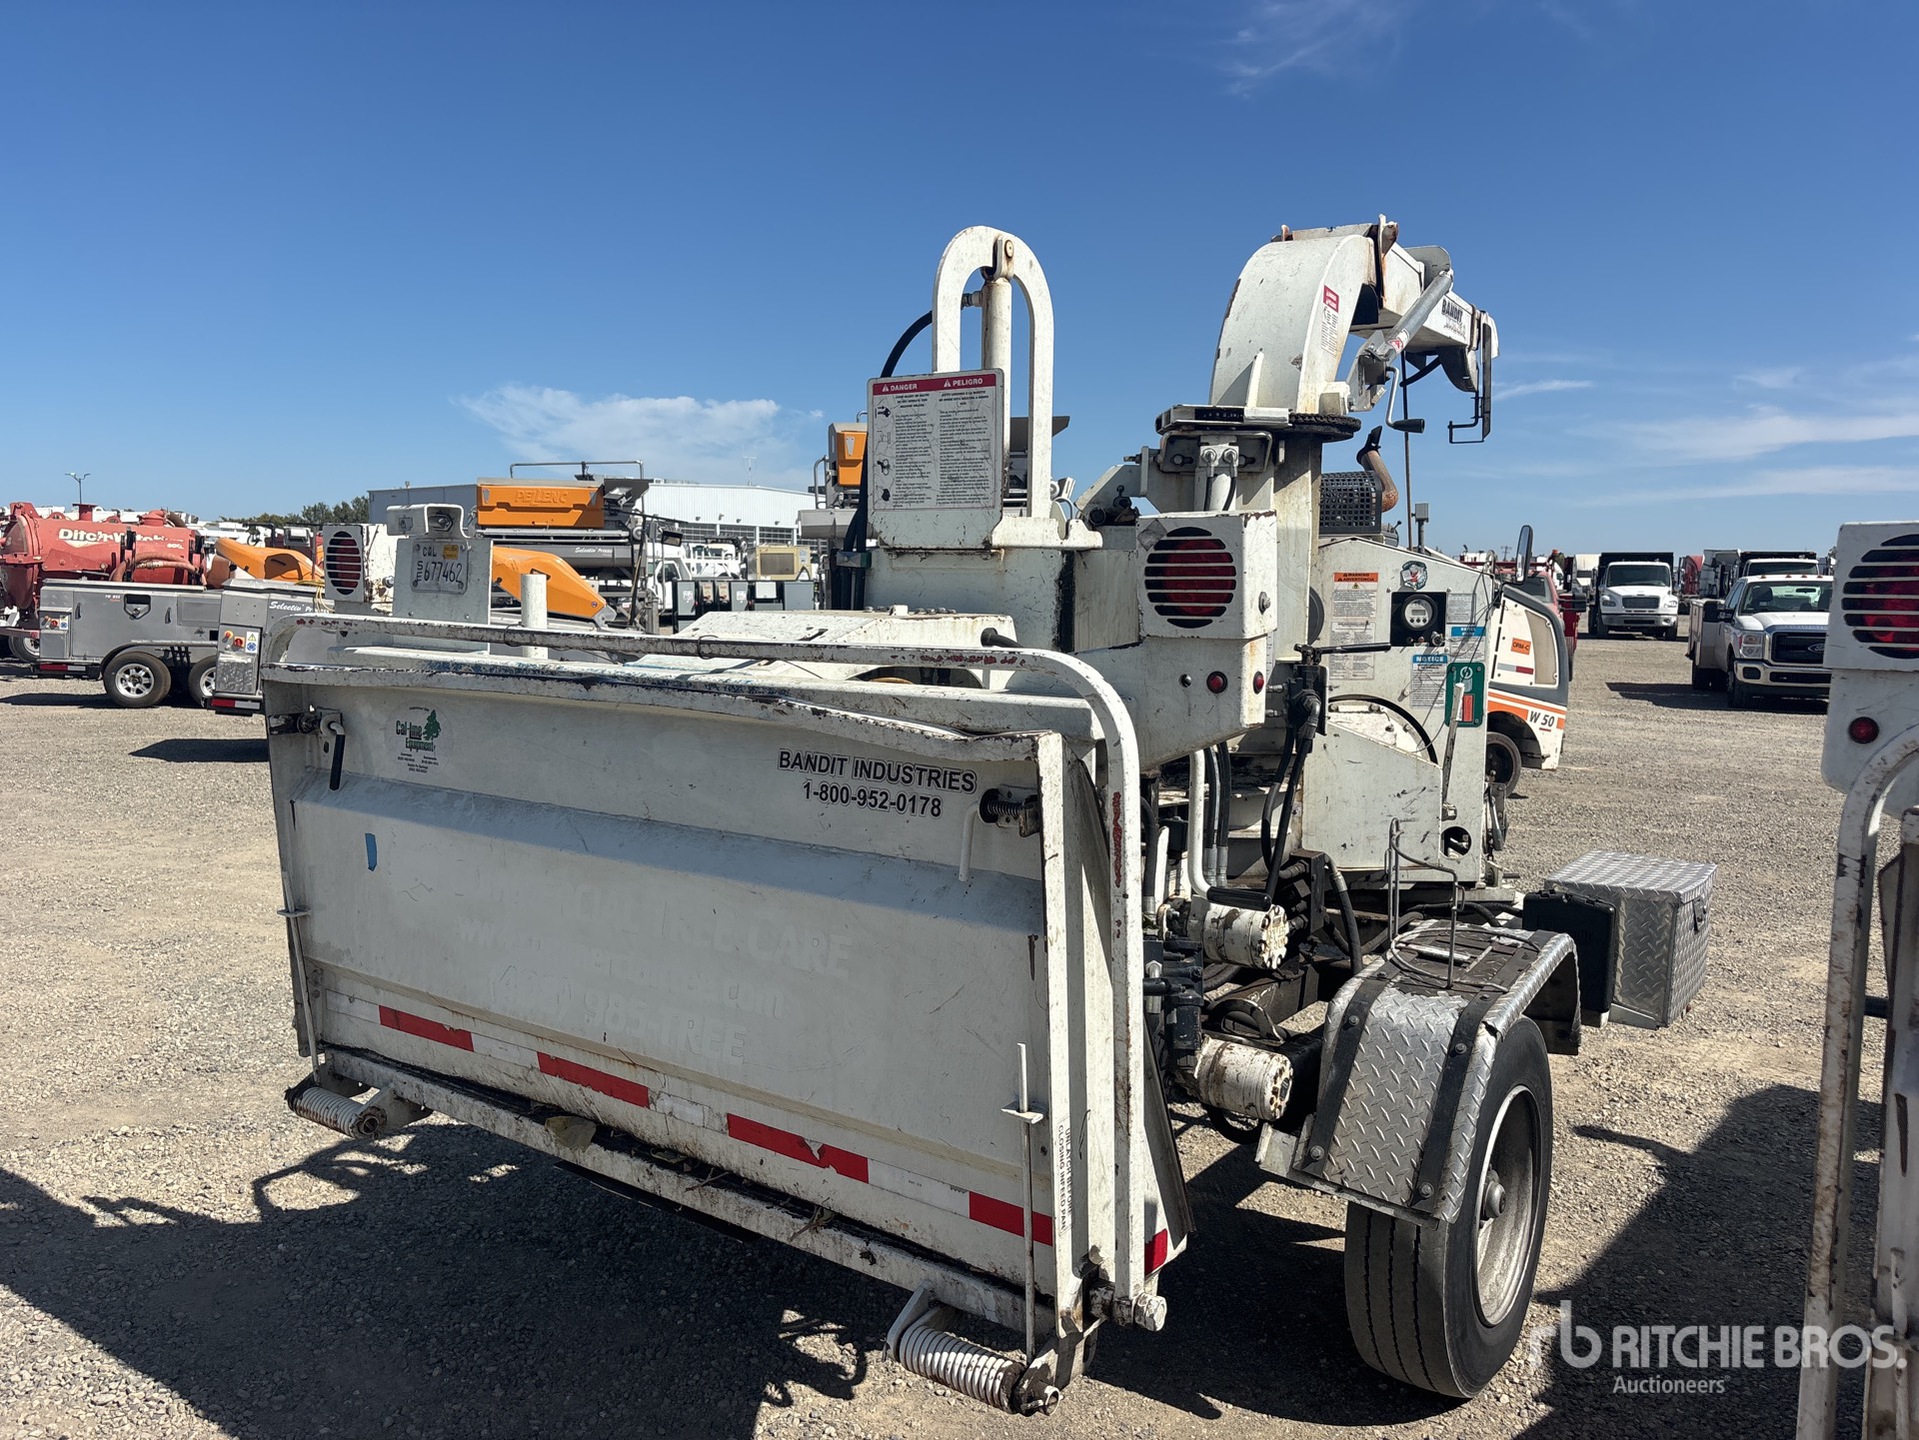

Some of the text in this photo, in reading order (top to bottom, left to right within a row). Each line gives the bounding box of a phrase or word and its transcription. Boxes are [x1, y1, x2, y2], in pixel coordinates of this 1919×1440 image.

[1441, 298, 1463, 324] BANDIT
[890, 383, 918, 392] DANGER
[952, 378, 984, 387] PELIGRO
[424, 561, 463, 583] 677462
[1415, 655, 1445, 663] NOTICE
[1529, 711, 1555, 728] W 50
[778, 750, 977, 793] BANDIT INDUSTRIES
[803, 781, 942, 818] 1-800-952-0178
